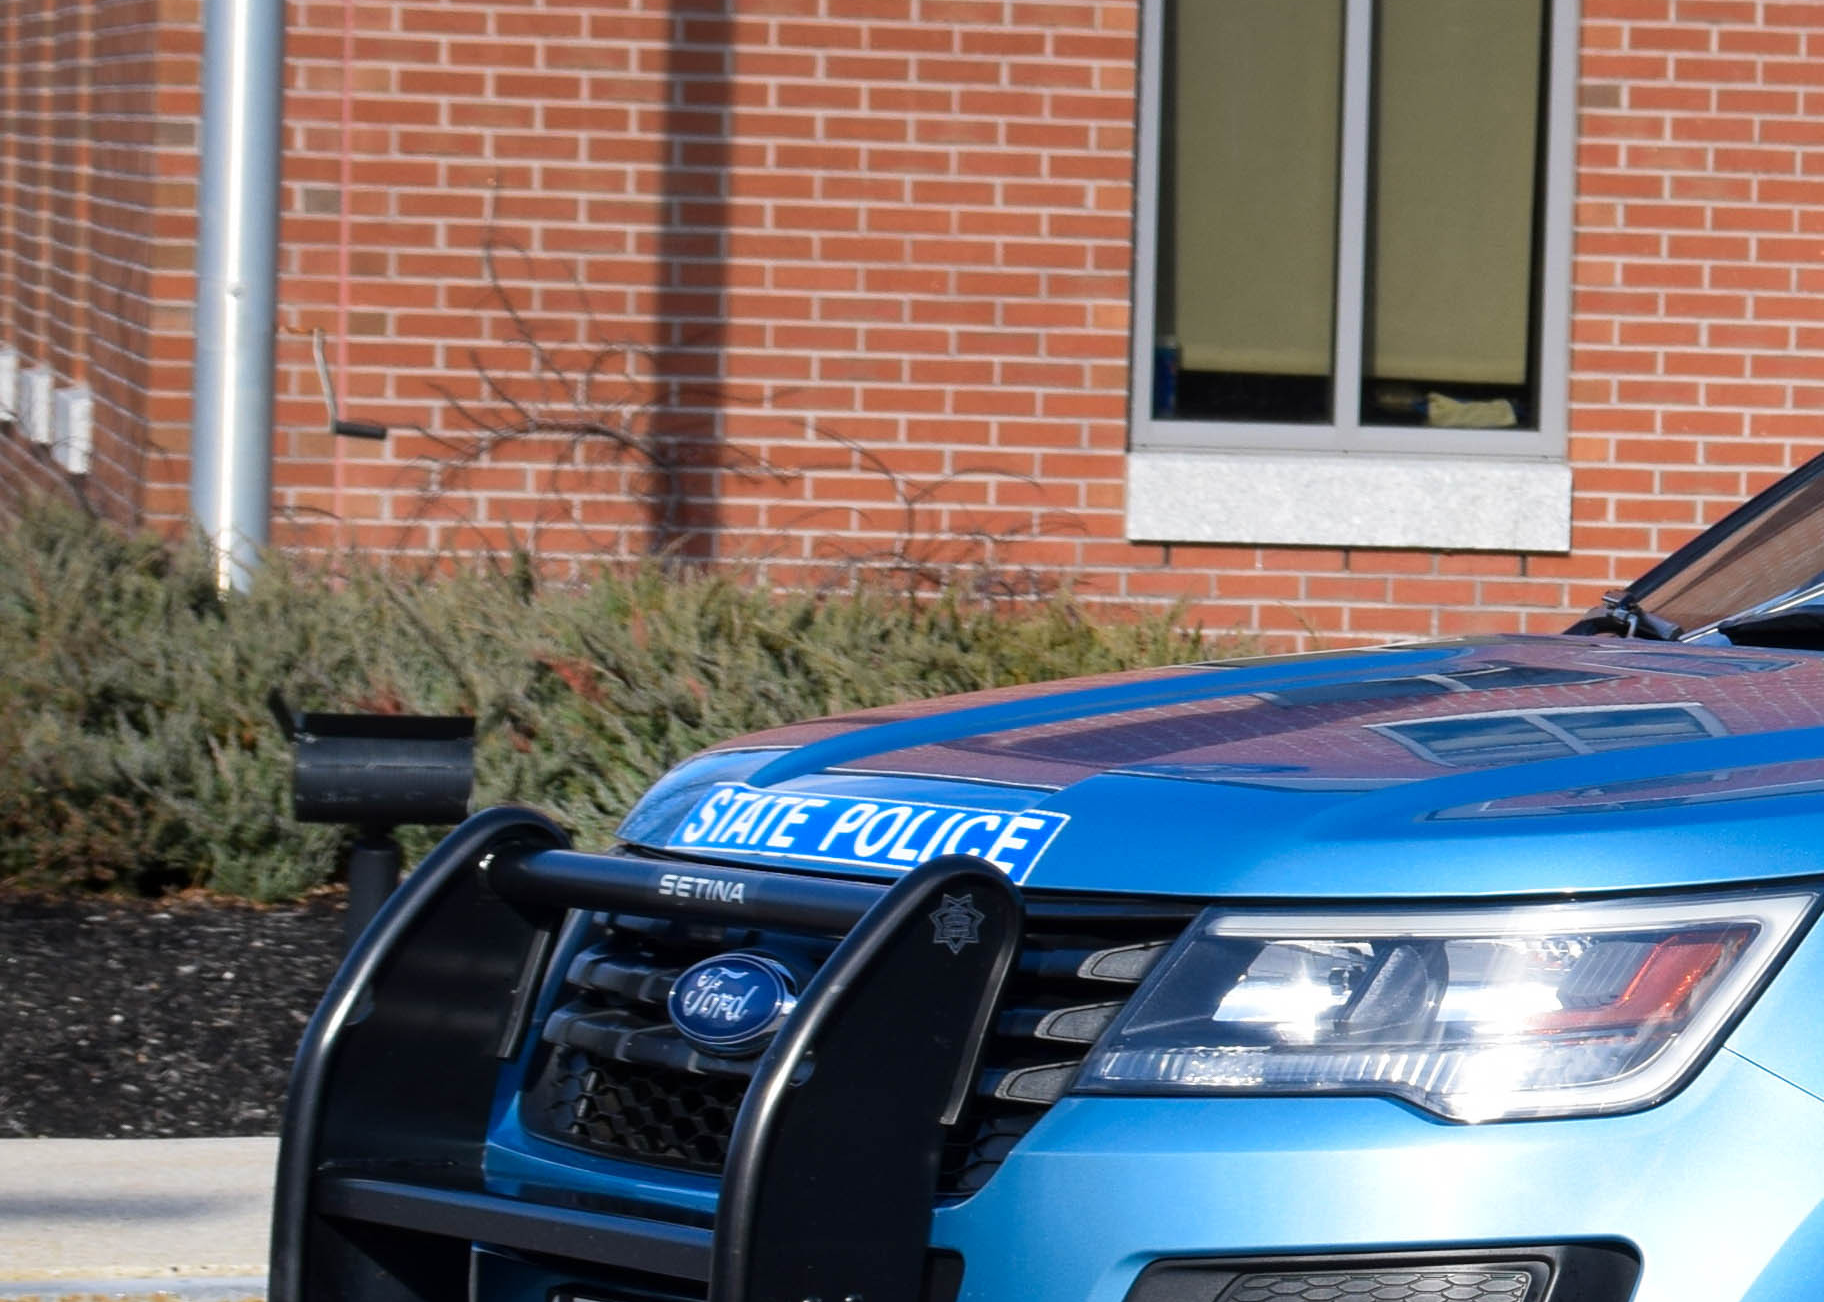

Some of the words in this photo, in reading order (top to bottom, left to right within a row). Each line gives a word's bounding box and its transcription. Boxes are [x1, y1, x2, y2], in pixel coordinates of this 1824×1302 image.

[682, 788, 830, 848] STATE
[818, 803, 1046, 874] POLICE
[659, 874, 745, 904] SETINA
[684, 967, 759, 1022] Ford
